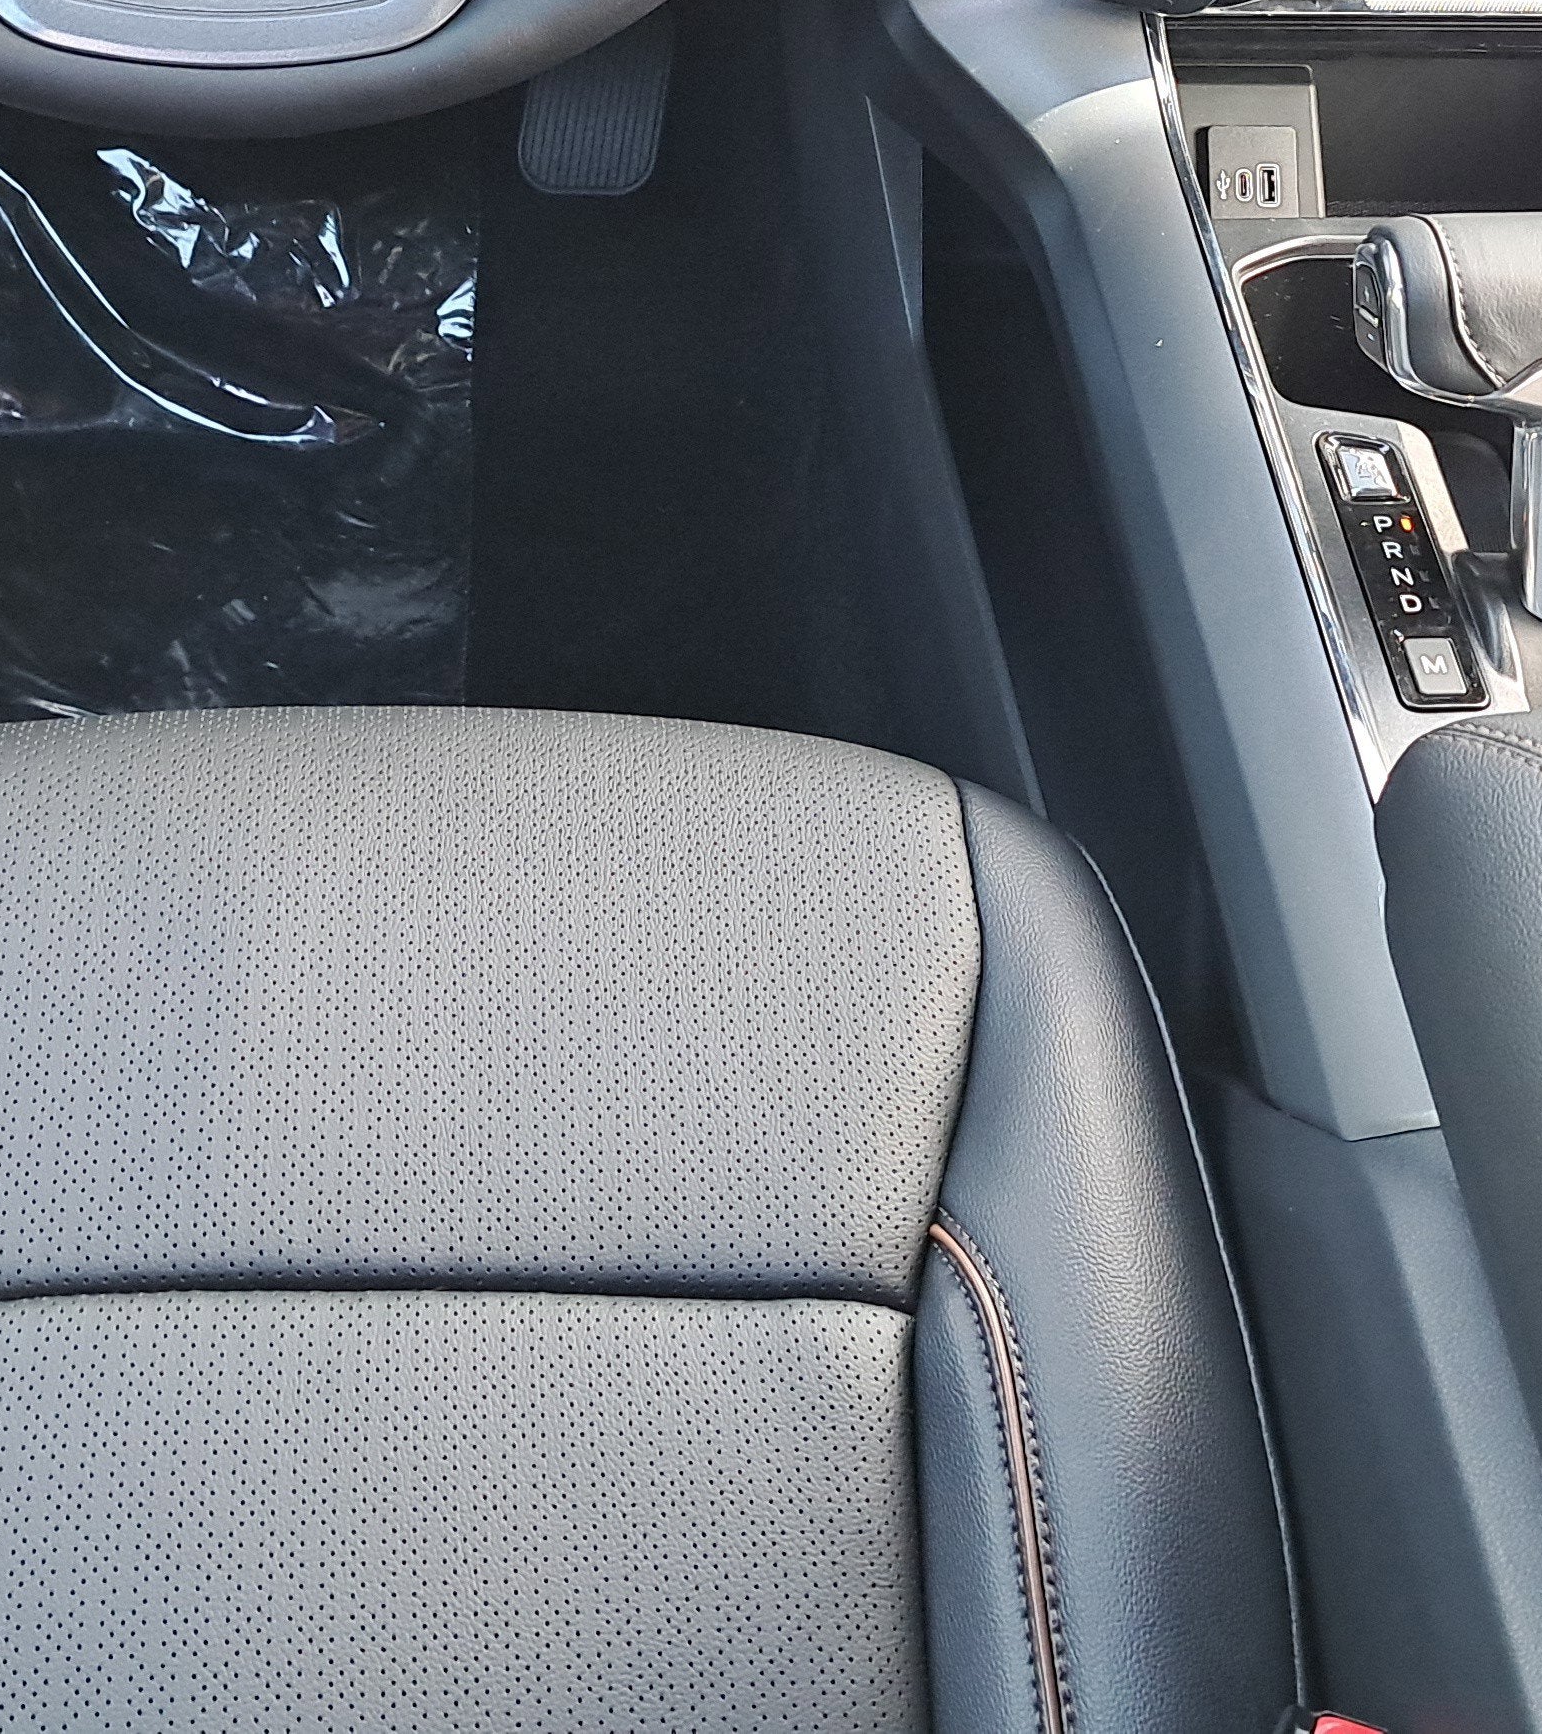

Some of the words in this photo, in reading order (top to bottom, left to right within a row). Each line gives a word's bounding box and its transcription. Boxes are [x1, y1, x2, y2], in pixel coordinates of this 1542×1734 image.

[1372, 515, 1393, 534] P
[1382, 541, 1404, 560] R
[1390, 567, 1415, 587] N
[1399, 594, 1423, 614] D
[1419, 654, 1448, 676] M
